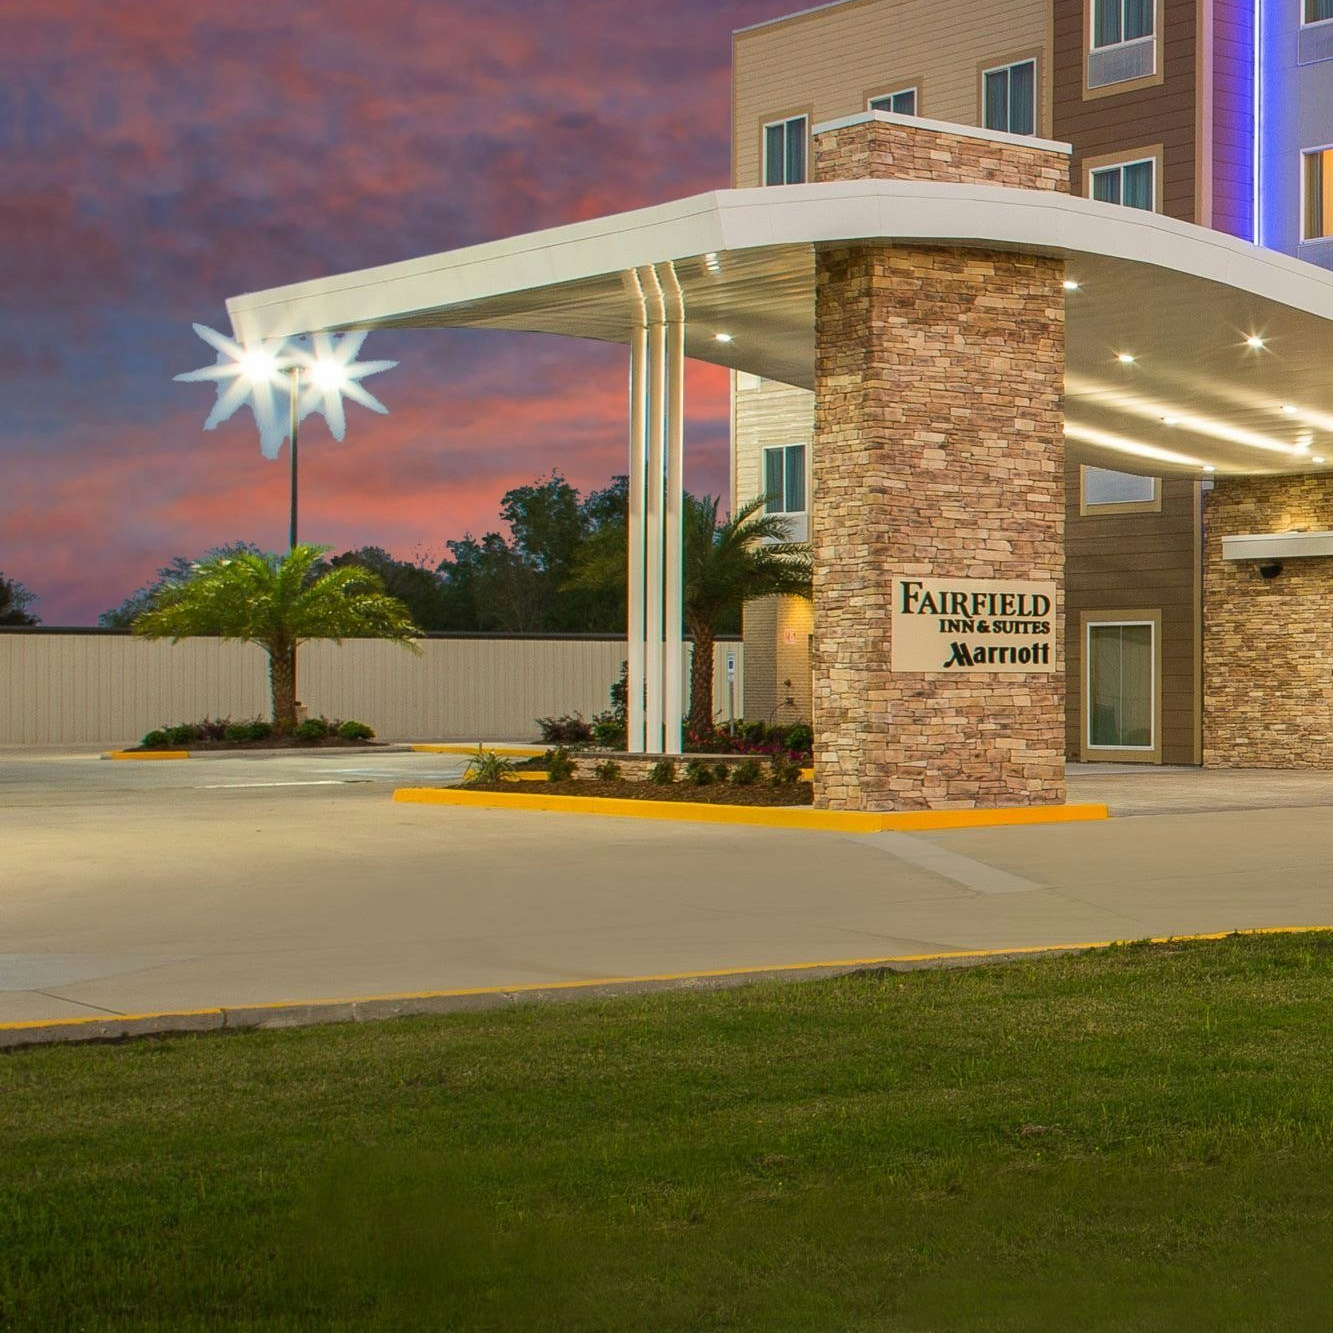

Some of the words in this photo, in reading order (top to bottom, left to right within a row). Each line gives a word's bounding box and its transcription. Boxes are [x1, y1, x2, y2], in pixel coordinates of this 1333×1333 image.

[900, 580, 1051, 619] FAIRFIELD
[938, 619, 975, 634] INN
[992, 620, 1051, 635] SUITES
[943, 641, 1050, 668] Marriott
